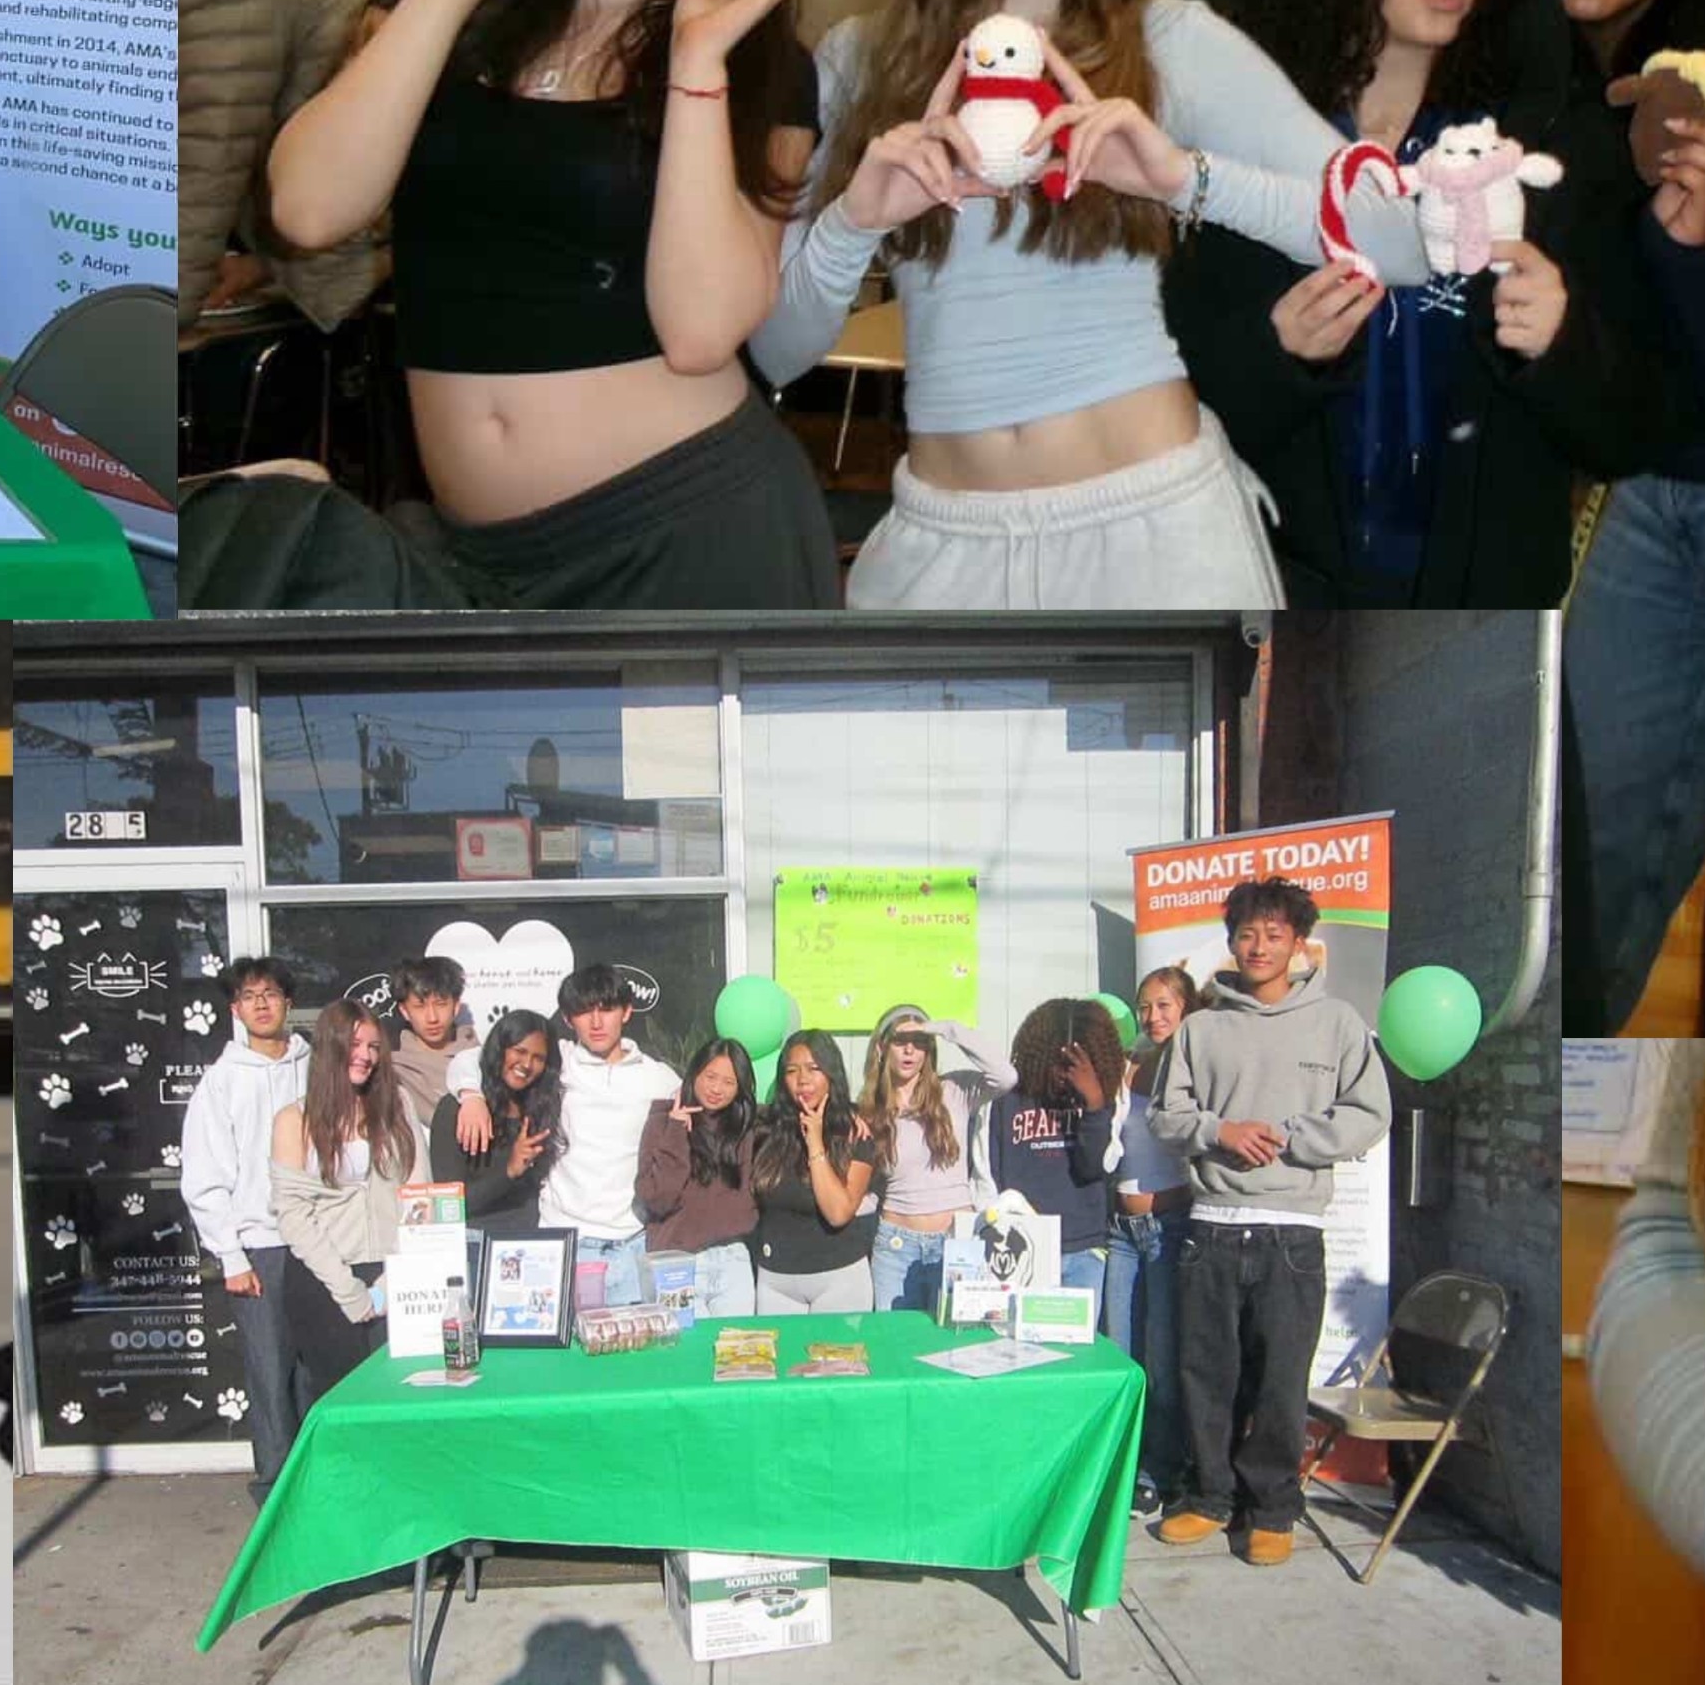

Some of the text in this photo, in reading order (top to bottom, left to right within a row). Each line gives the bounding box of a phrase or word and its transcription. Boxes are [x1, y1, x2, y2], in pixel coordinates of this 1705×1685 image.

[23, 2, 129, 28] rehabilitating
[81, 59, 145, 78] animals
[25, 71, 165, 103] ultimately finding
[72, 105, 153, 129] continued
[29, 119, 83, 140] critical
[71, 164, 129, 186] chance
[48, 208, 120, 242] Ways
[81, 254, 132, 276] Adopt
[1146, 834, 1371, 889] DONATE TODAY!
[900, 913, 972, 926] DONATIONS
[178, 1254, 201, 1269] US:
[184, 1313, 205, 1326] US:
[724, 1572, 779, 1589] SOYBEAN
